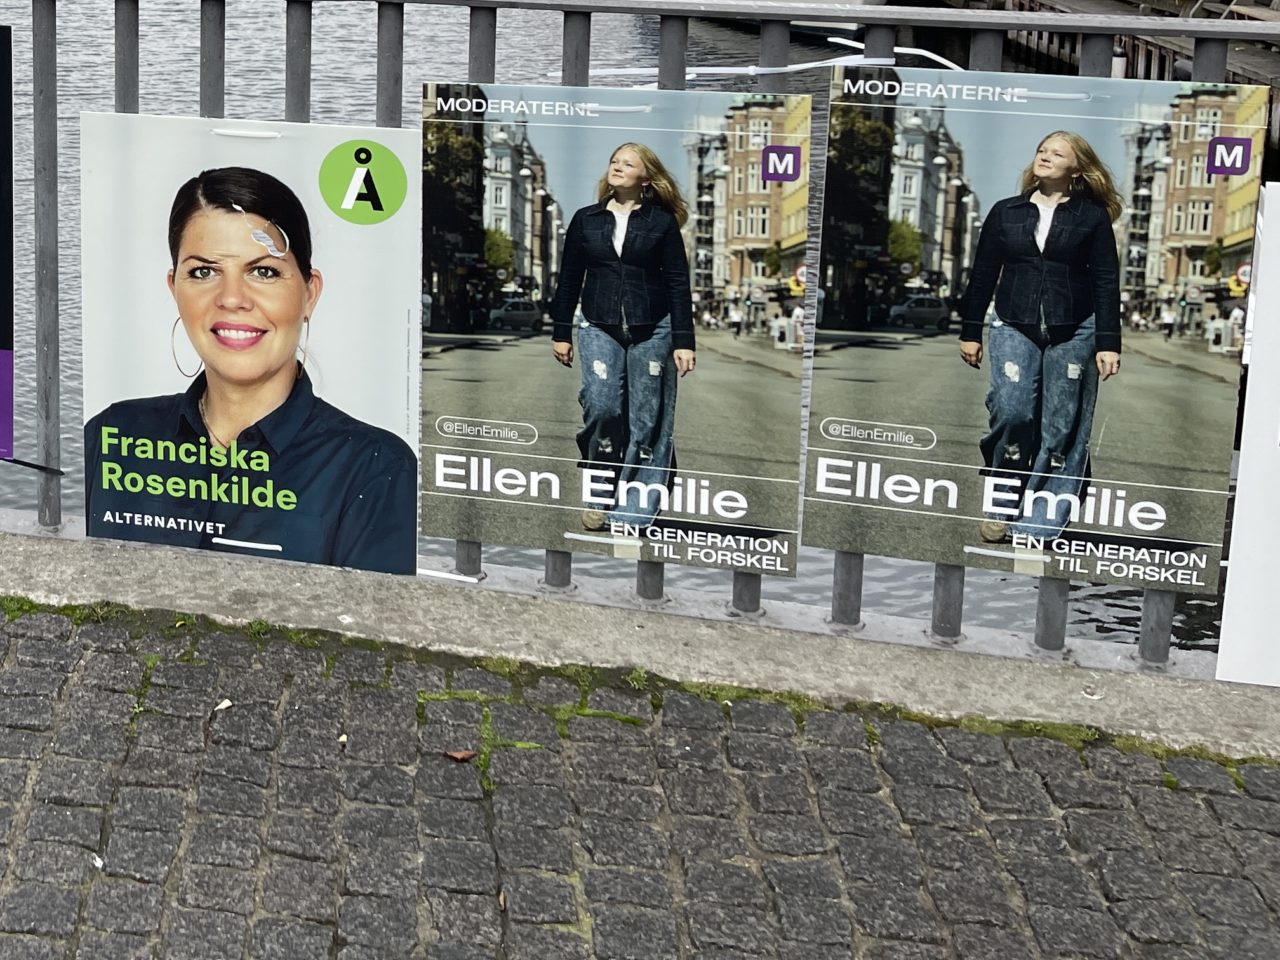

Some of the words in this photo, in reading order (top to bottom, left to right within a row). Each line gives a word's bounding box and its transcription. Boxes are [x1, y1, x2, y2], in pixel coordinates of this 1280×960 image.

[843, 78, 1028, 103] MODERATERNE
[436, 97, 600, 117] MODERATERNE
[768, 152, 795, 175] M
[1214, 144, 1244, 168] M
[340, 147, 384, 212] Å
[101, 426, 271, 473] Franciska
[102, 462, 298, 511] Rosenkilde
[434, 453, 561, 500] Ellen
[581, 468, 749, 519] Emilie
[815, 458, 959, 510] Ellen
[982, 476, 1168, 531] Emilie
[103, 511, 226, 536] ALTERNATIVET
[610, 521, 641, 537] EN
[646, 524, 789, 555] GENERATION
[649, 542, 682, 557] TIL
[687, 546, 789, 572] FORSKEL
[1011, 533, 1045, 551] EN
[1051, 538, 1208, 569] GENERATION
[1056, 557, 1090, 574] TIL
[1096, 560, 1206, 587] FORSKEL
